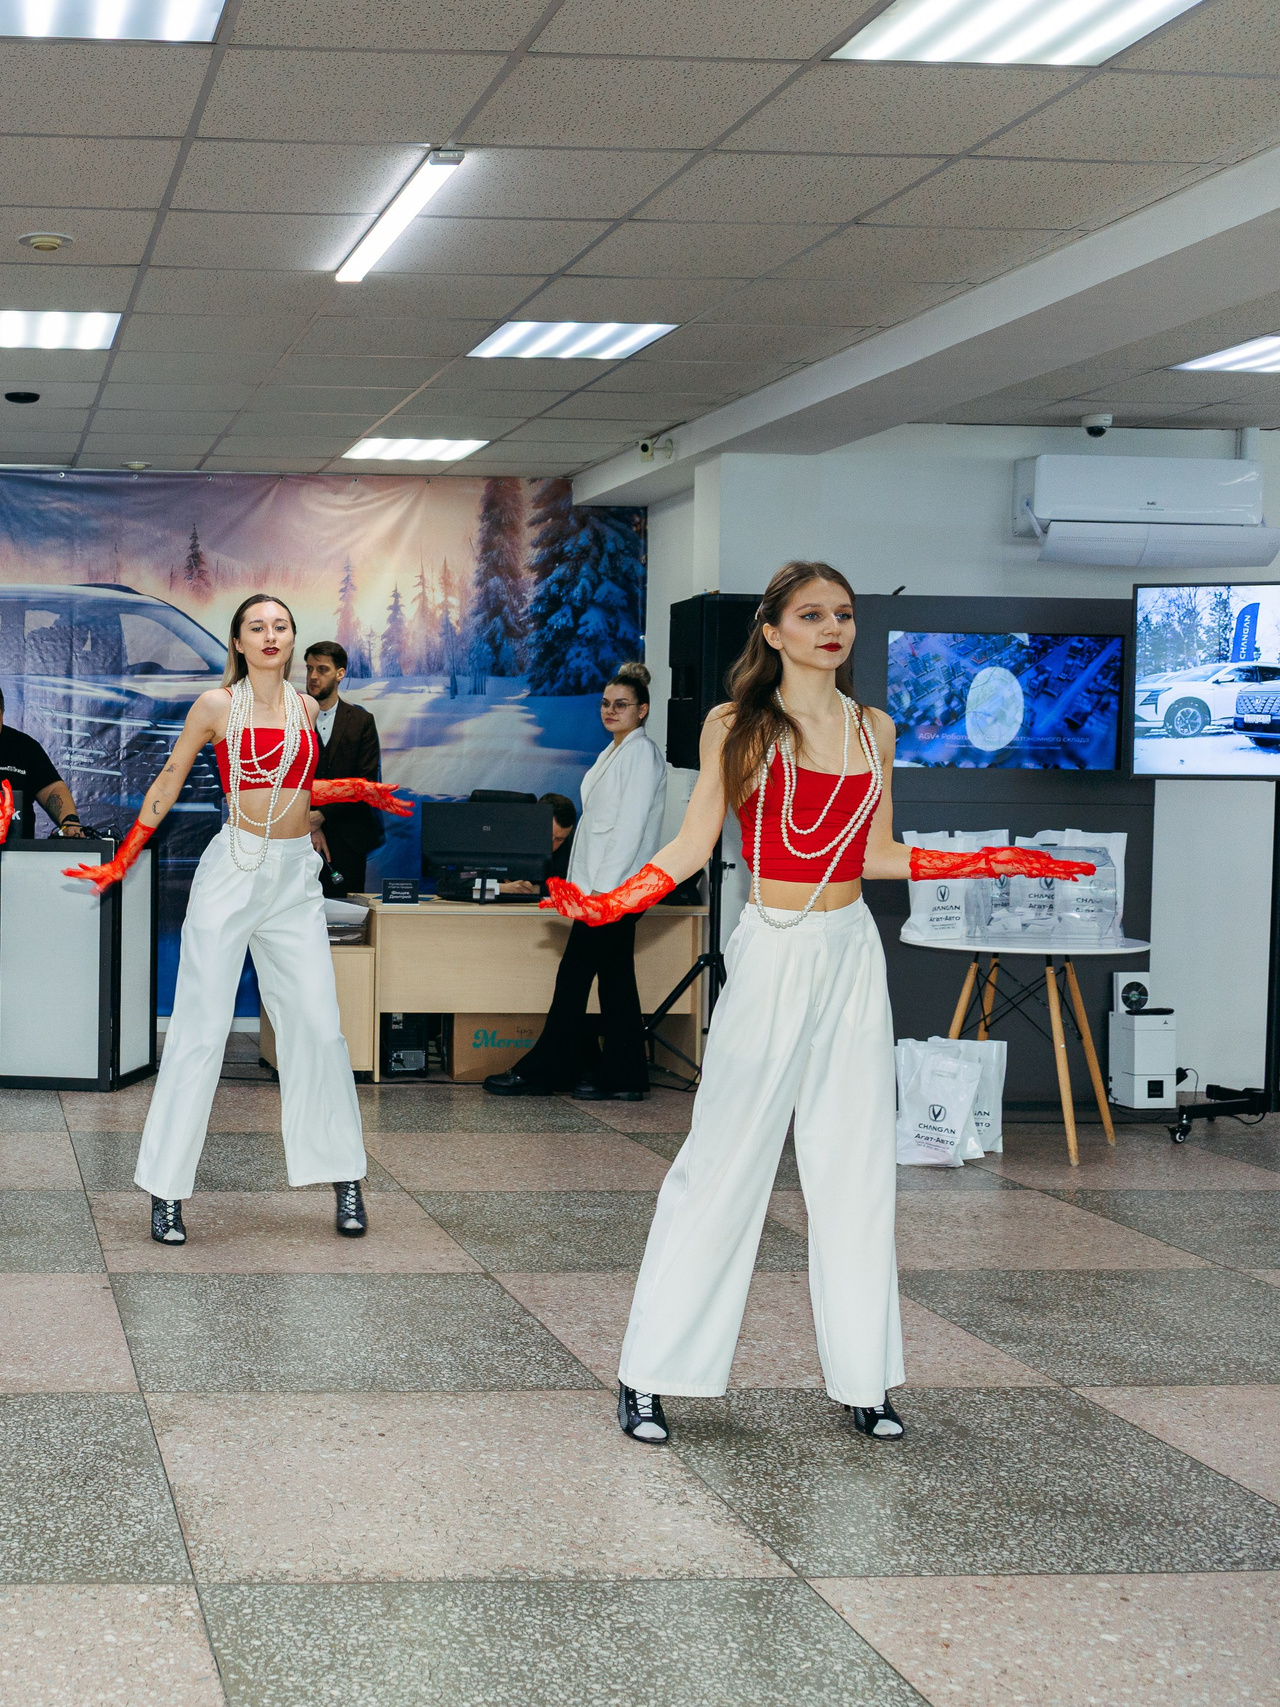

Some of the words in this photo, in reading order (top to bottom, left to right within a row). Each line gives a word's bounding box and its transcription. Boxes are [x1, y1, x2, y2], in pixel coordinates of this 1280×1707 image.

[1239, 614, 1251, 660] CHANGAN
[918, 1123, 956, 1135] CHANGAN
[914, 1133, 955, 1146] Агат-Авто
